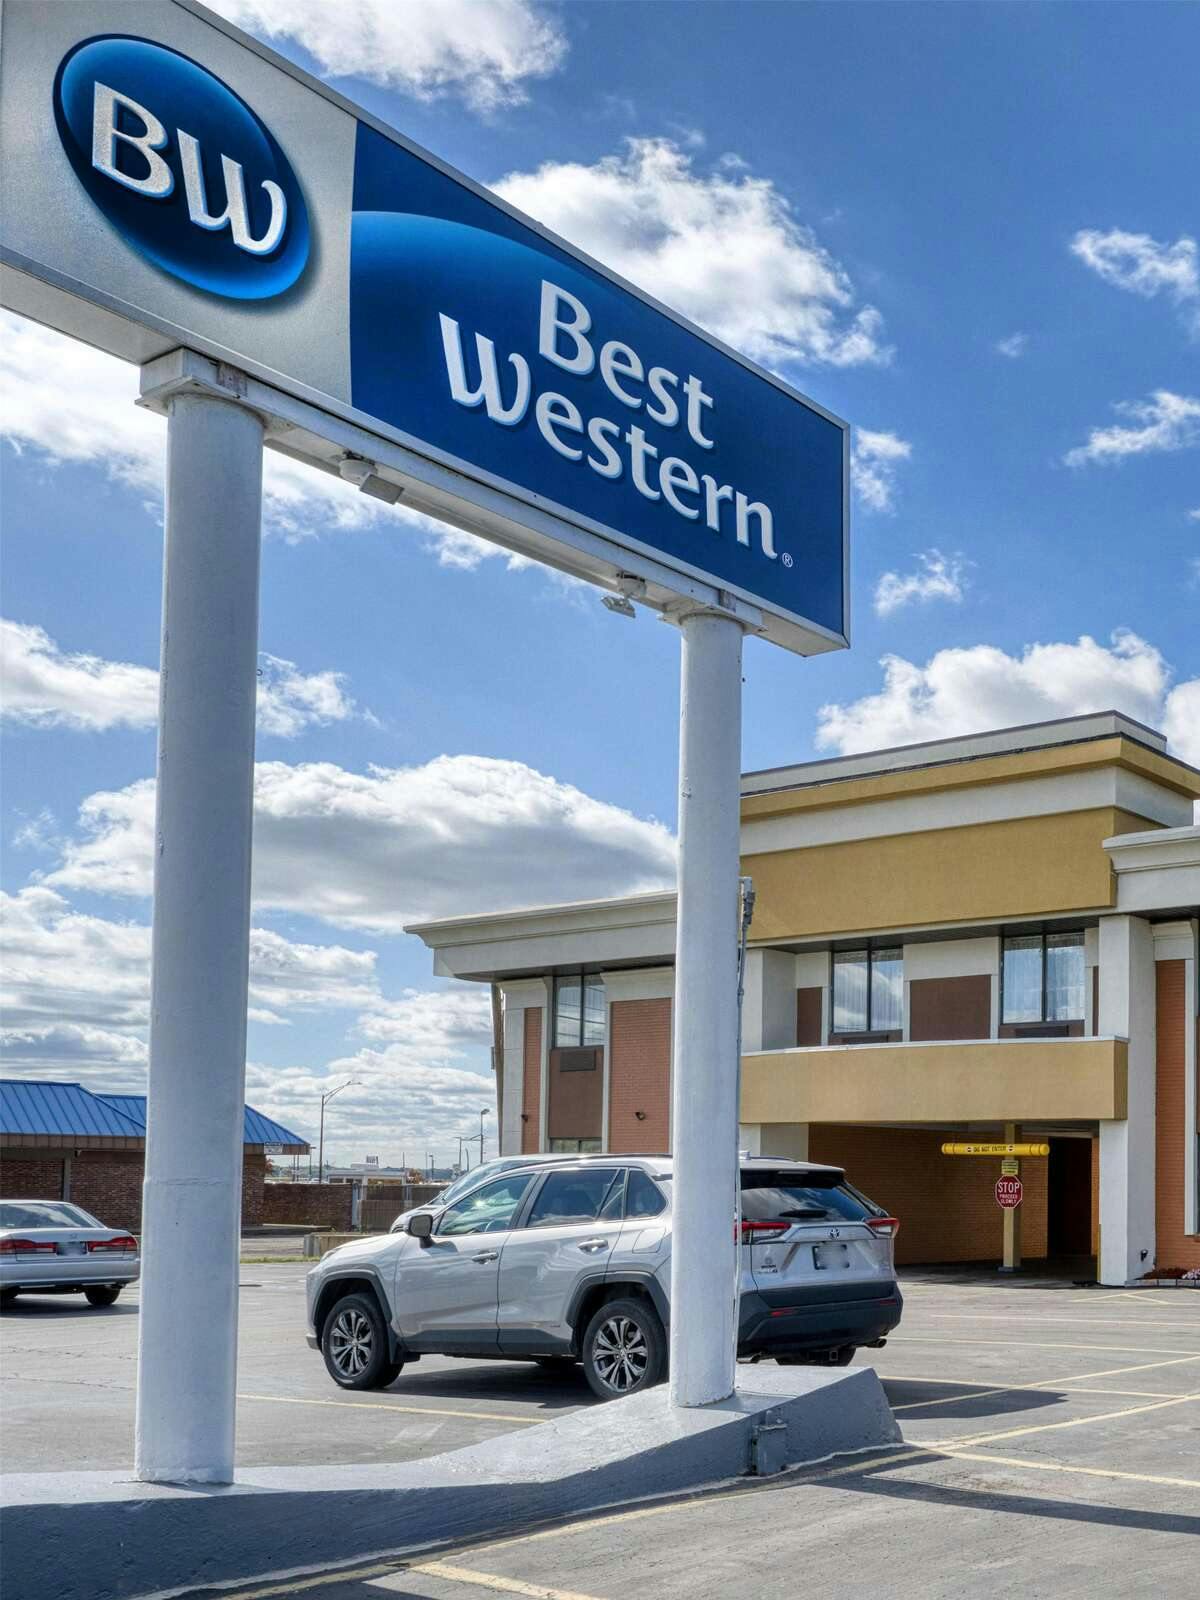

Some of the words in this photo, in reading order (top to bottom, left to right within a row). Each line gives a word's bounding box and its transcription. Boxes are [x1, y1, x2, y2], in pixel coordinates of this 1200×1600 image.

[92, 80, 287, 255] BW
[438, 311, 778, 560] Western
[539, 279, 714, 449] Best
[998, 1182, 1020, 1193] STOP
